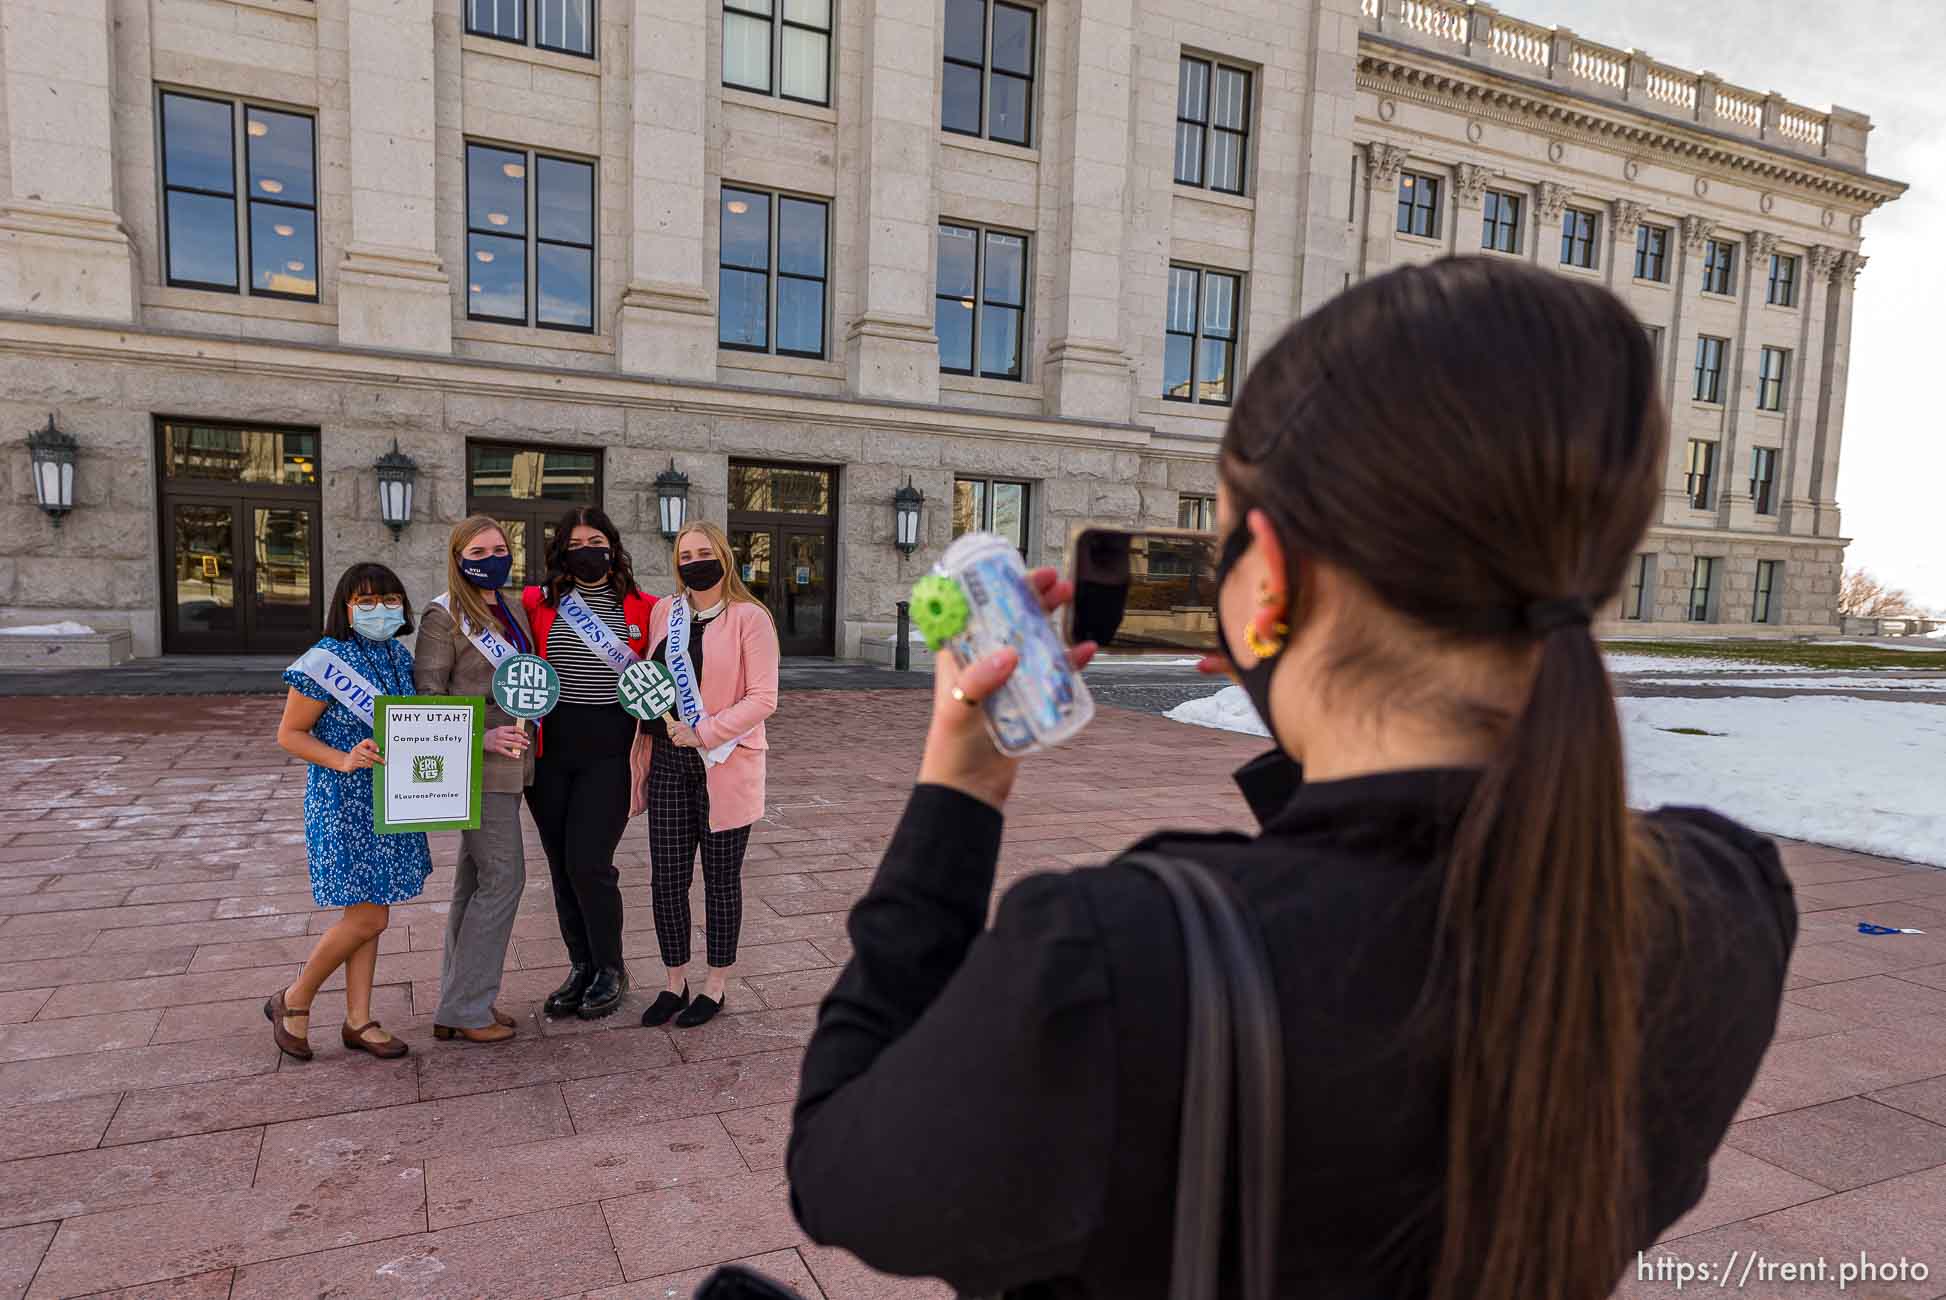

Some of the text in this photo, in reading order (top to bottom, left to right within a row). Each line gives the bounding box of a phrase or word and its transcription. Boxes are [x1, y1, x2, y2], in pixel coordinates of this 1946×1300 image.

[560, 594, 625, 663] VOTES FOR
[507, 661, 547, 688] ERA
[670, 594, 700, 728] TES FOR WOMEN
[323, 662, 374, 717] VOTE
[618, 661, 664, 702] ERA
[503, 686, 549, 709] YES
[628, 679, 676, 720] YES
[391, 713, 468, 722] WHY UTAH?
[393, 735, 463, 744] Campus Safety
[418, 769, 439, 780] YES
[419, 758, 438, 771] ERA
